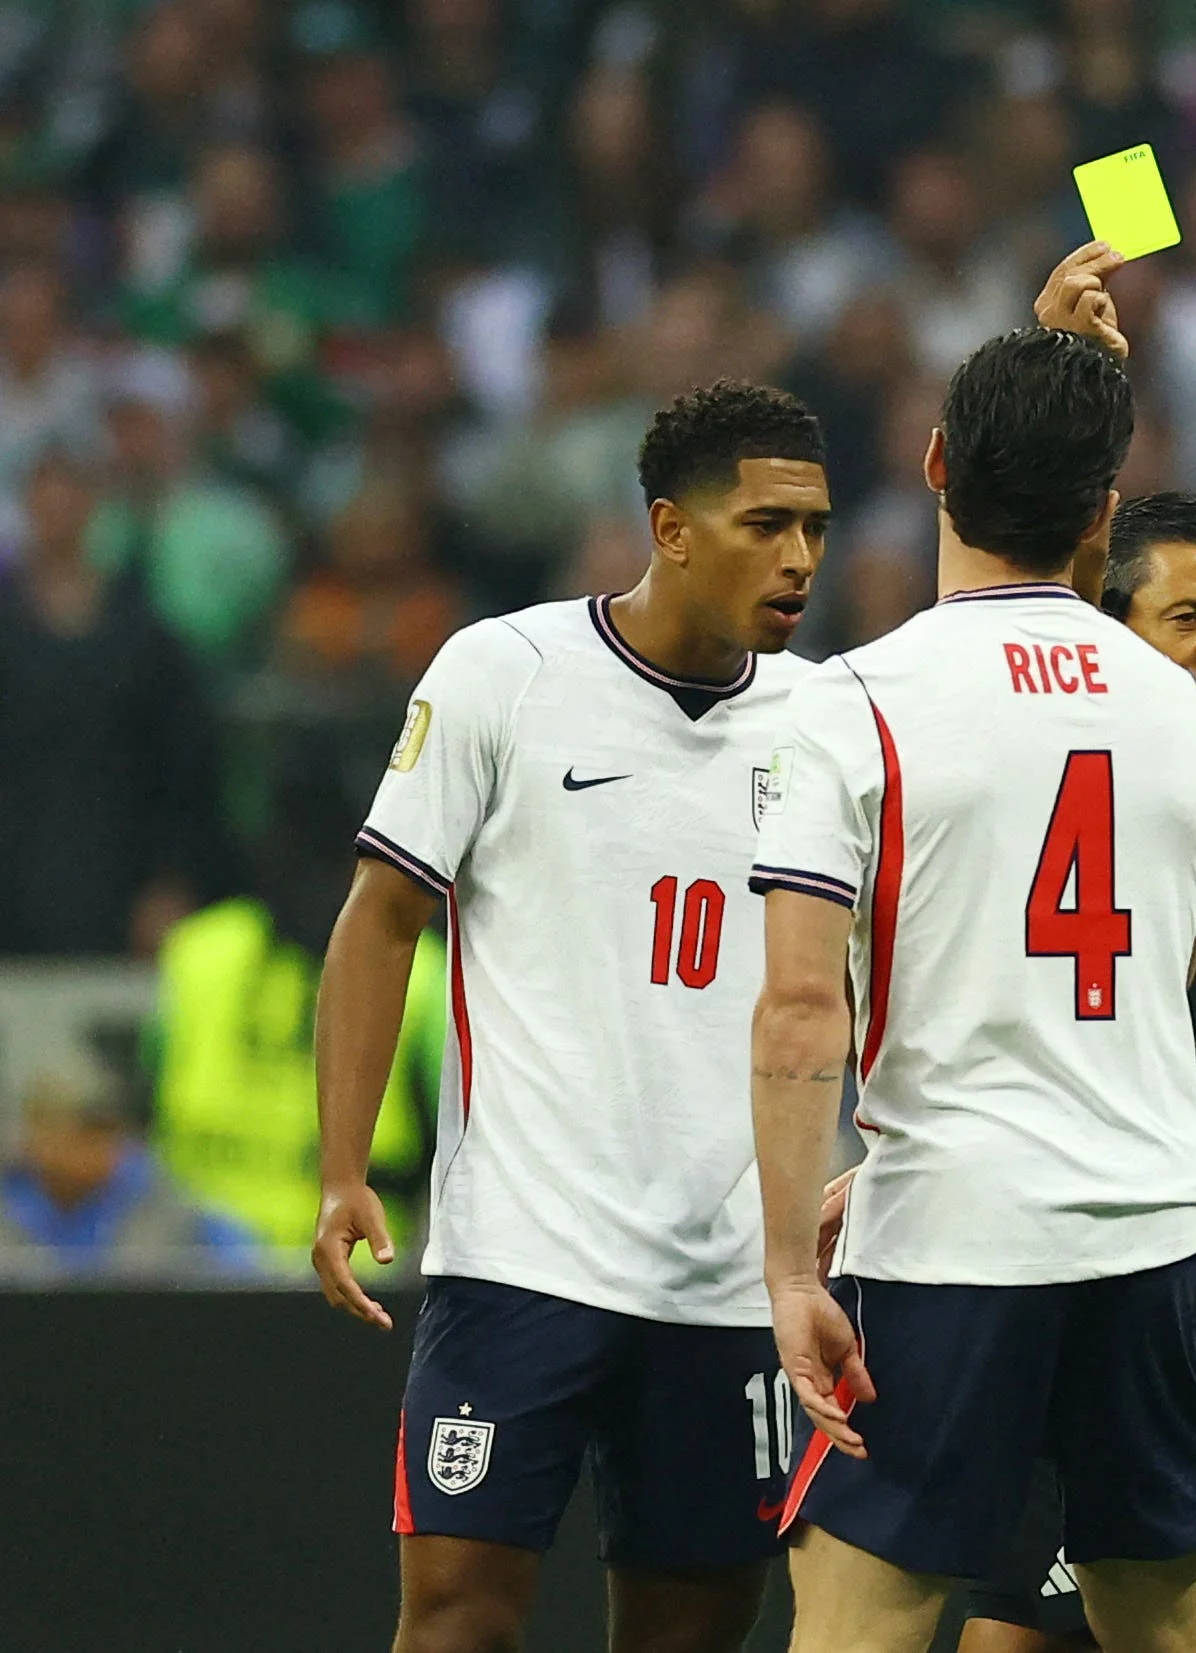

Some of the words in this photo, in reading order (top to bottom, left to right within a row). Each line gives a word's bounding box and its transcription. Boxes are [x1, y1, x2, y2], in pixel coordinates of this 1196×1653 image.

[1124, 151, 1146, 163] FIFA
[1003, 643, 1108, 694] RICE
[650, 875, 726, 990] 10
[1025, 750, 1132, 1020] 4
[745, 1368, 792, 1479] 10
